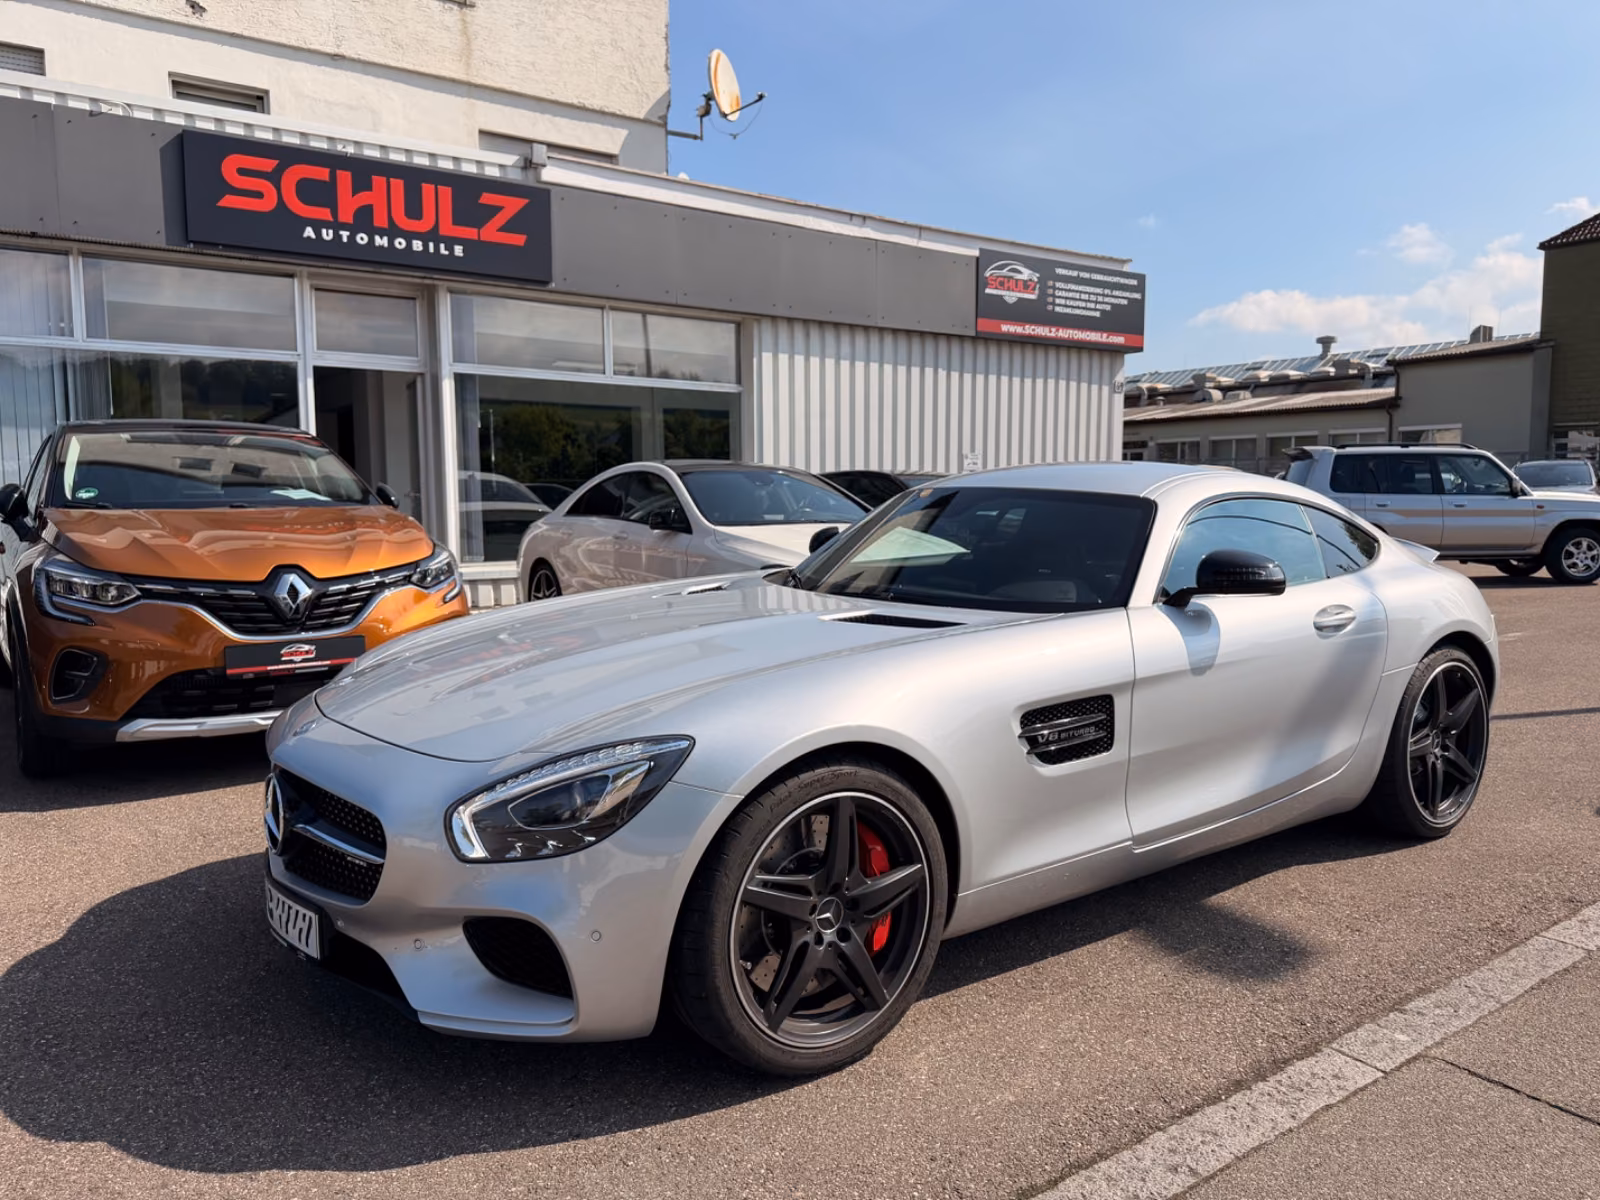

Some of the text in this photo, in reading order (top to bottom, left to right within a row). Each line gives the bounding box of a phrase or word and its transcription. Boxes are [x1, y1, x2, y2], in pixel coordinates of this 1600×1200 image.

[216, 154, 530, 247] SCHULZ
[303, 226, 464, 257] AUTOMOBILE
[986, 275, 1036, 295] SCHULZ
[1001, 324, 1125, 344] www.SCHULZ-AUTOMOBILE.com
[1037, 726, 1095, 743] V8 BITURBO
